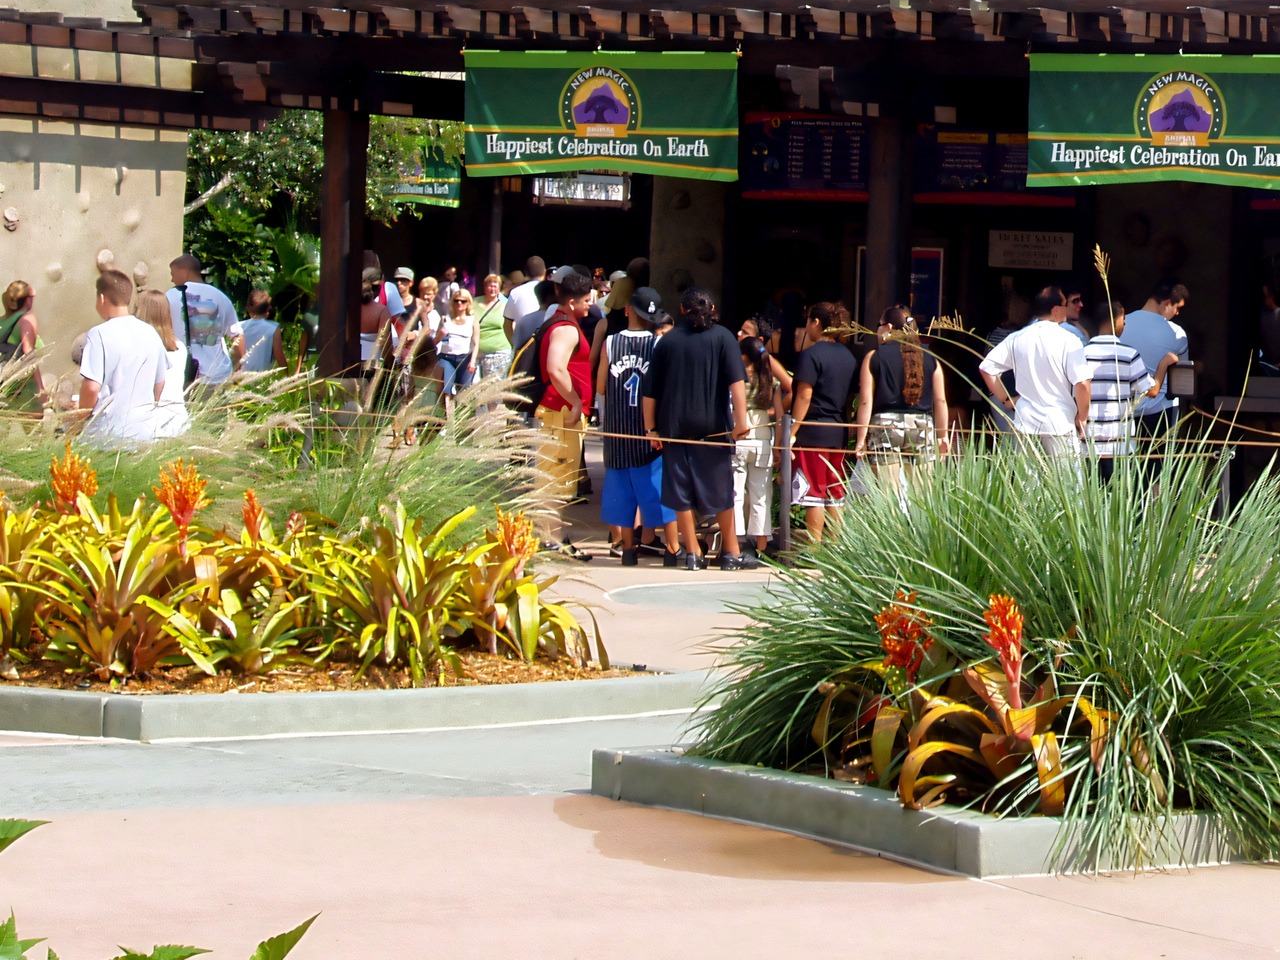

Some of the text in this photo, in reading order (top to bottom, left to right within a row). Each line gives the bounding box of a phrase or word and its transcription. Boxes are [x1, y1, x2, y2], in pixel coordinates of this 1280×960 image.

[571, 67, 629, 91] NEW MAGIC
[1148, 71, 1214, 97] NEW MAGIC
[486, 133, 709, 159] Happiest Celebration On Earth
[1051, 141, 1126, 169] Happiest
[1130, 144, 1220, 167] Celebration
[1226, 147, 1247, 167] On
[623, 372, 640, 407] 1
